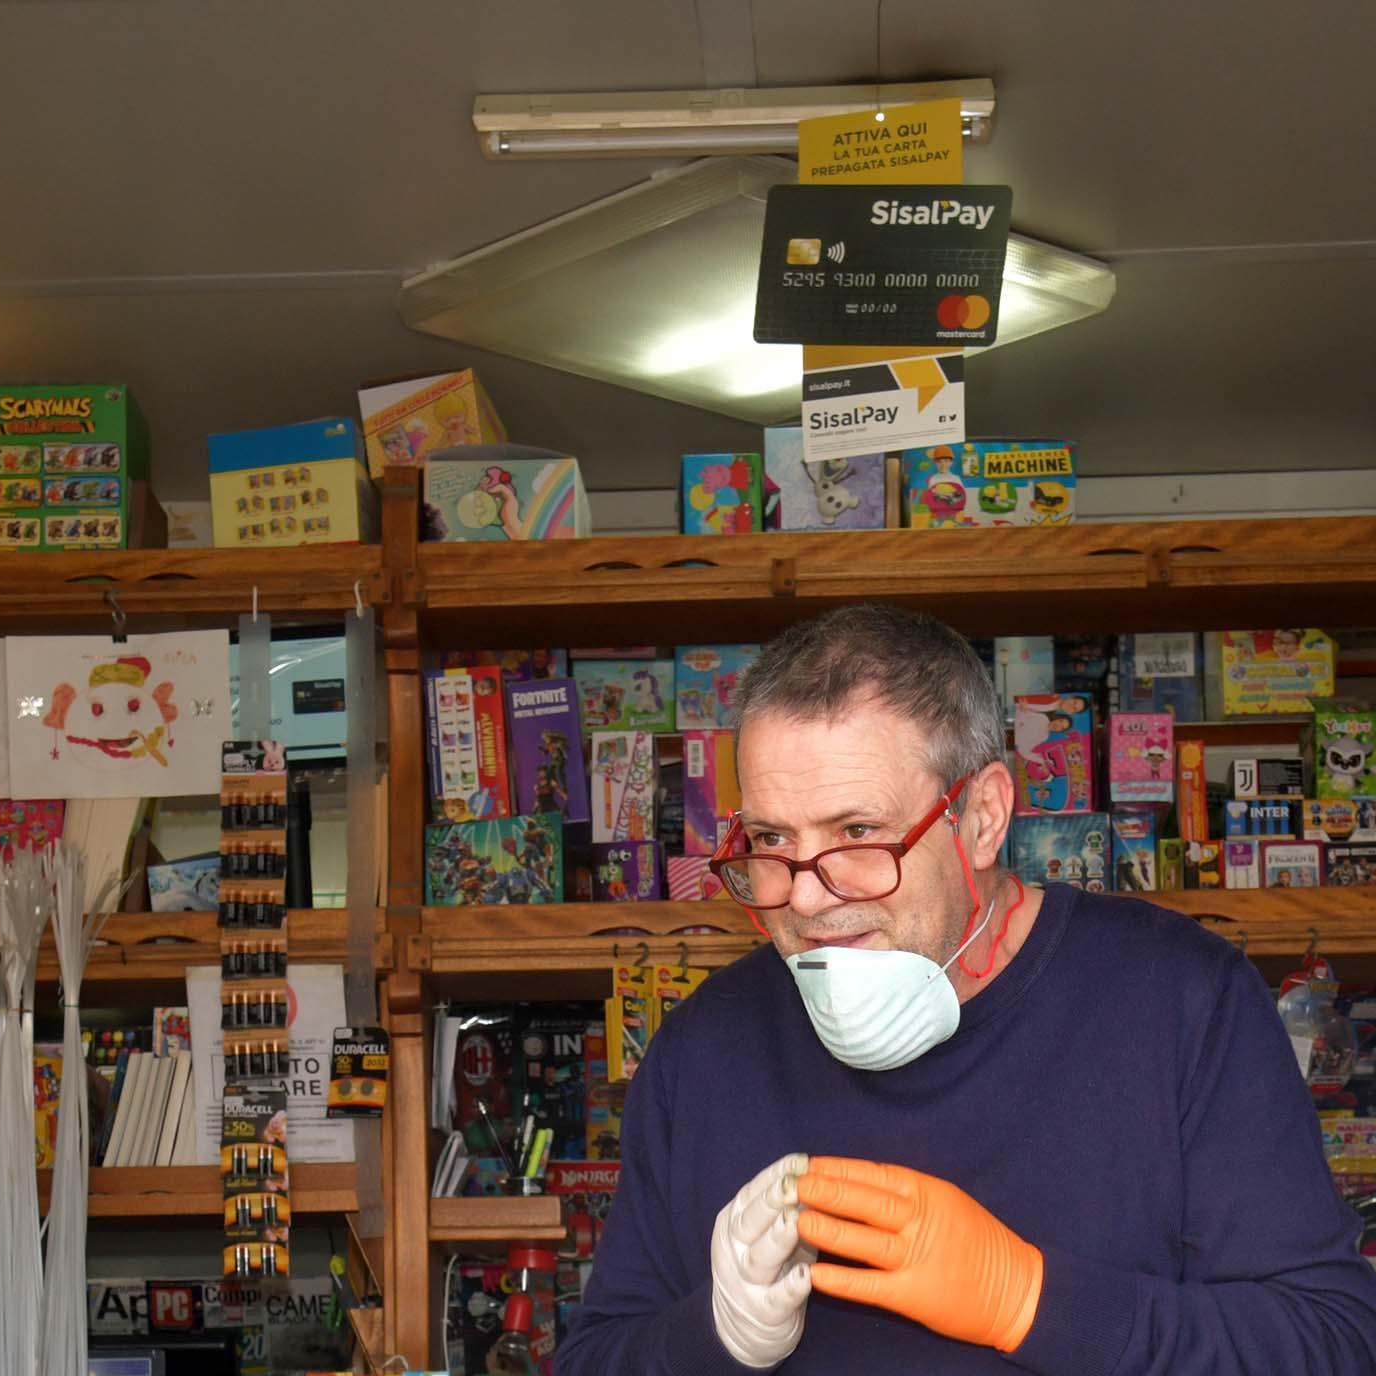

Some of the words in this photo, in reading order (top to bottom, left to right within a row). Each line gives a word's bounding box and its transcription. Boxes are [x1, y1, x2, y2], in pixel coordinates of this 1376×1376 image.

[833, 128, 891, 146] ATTIVA
[896, 122, 928, 139] QUI
[833, 149, 851, 161] LA
[855, 145, 880, 158] TUA
[884, 139, 927, 154] CARTA
[811, 159, 885, 178] PREPAGATA
[889, 149, 950, 168] SISALPAY
[870, 199, 995, 230] SisalPay
[782, 272, 825, 287] 5295
[833, 272, 875, 287] 9300
[884, 272, 928, 288] 0000
[936, 272, 980, 288] 0000
[936, 329, 986, 340] mastercard
[0, 396, 92, 420] SCARYMALS
[809, 405, 899, 430] SisalPay
[987, 457, 1069, 475] MACHINE
[511, 687, 568, 709] FORTNITE
[1249, 806, 1290, 819] INTER
[334, 1044, 387, 1056] DURACELL
[155, 1290, 190, 1321] PC
